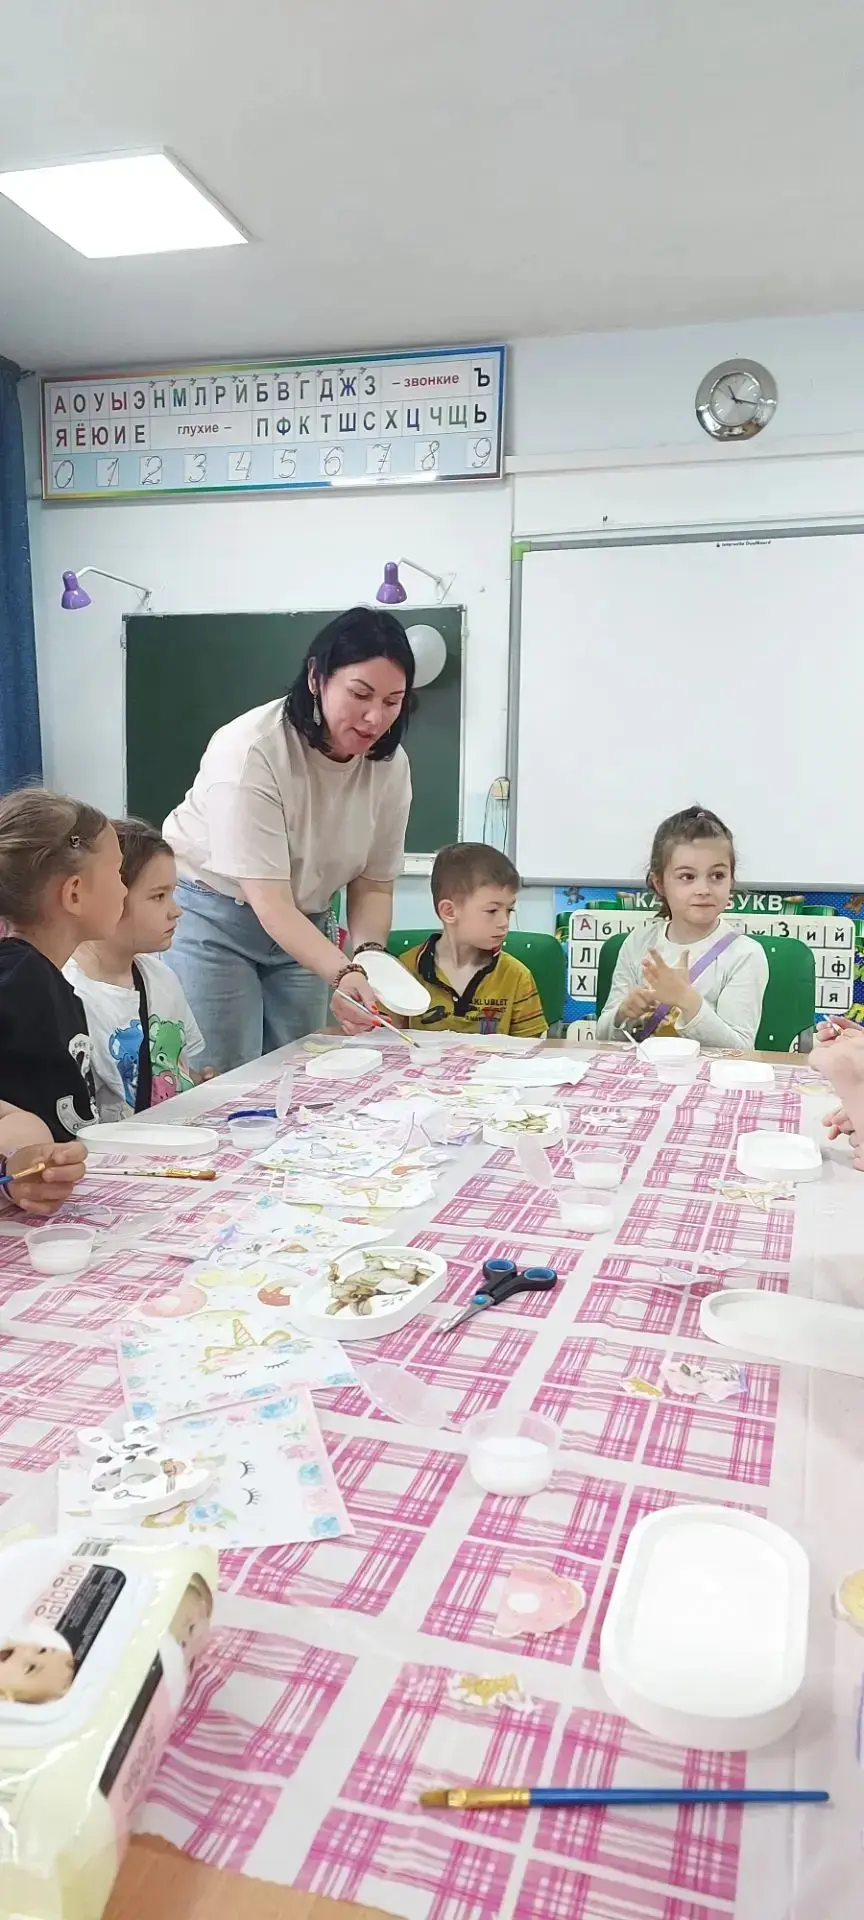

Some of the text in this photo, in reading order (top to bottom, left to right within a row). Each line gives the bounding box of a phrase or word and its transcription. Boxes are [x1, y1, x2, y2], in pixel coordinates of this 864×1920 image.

[404, 375, 459, 388] звонкие
[178, 424, 219, 437] глухие
[55, 438, 491, 488] 0 1 2 3 4 5 6 7 8 9
[580, 918, 591, 931] А
[602, 922, 612, 935] б
[807, 932, 816, 941] и
[835, 928, 844, 942] й
[580, 948, 591, 963] Л
[831, 960, 846, 976] ф
[829, 993, 838, 1002] я
